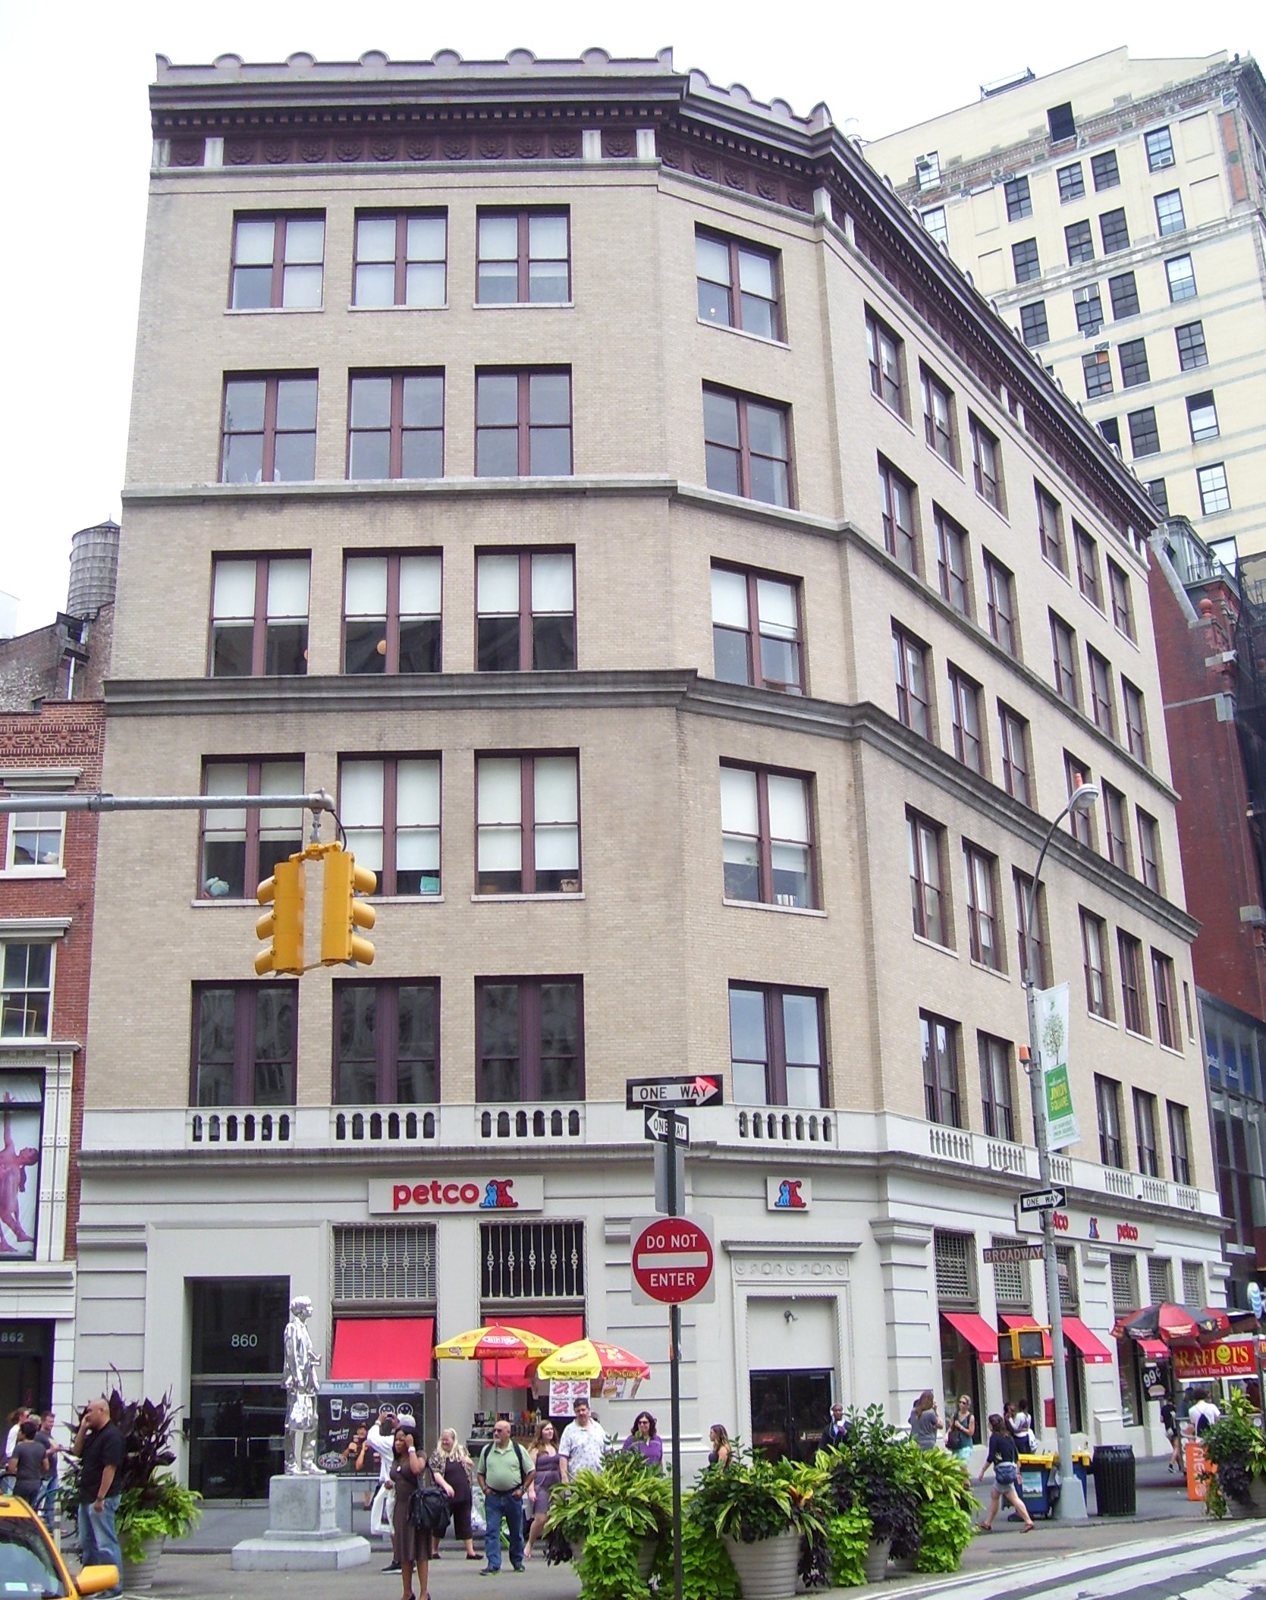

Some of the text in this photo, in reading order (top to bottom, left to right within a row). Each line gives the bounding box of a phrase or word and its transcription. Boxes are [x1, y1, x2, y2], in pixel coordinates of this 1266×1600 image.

[640, 1084, 708, 1100] ONE WAY
[653, 1118, 685, 1137] ONE AY
[393, 1179, 480, 1211] petco
[1026, 1194, 1059, 1207] ONE WAY
[1053, 1210, 1069, 1231] tco
[1117, 1222, 1138, 1242] petco
[646, 1234, 698, 1249] DO NOT
[985, 1247, 1042, 1262] BROADWAY
[650, 1272, 695, 1287] ENTER
[1, 1332, 24, 1343] 862
[231, 1334, 258, 1347] 860
[1143, 1366, 1162, 1388] 99¢
